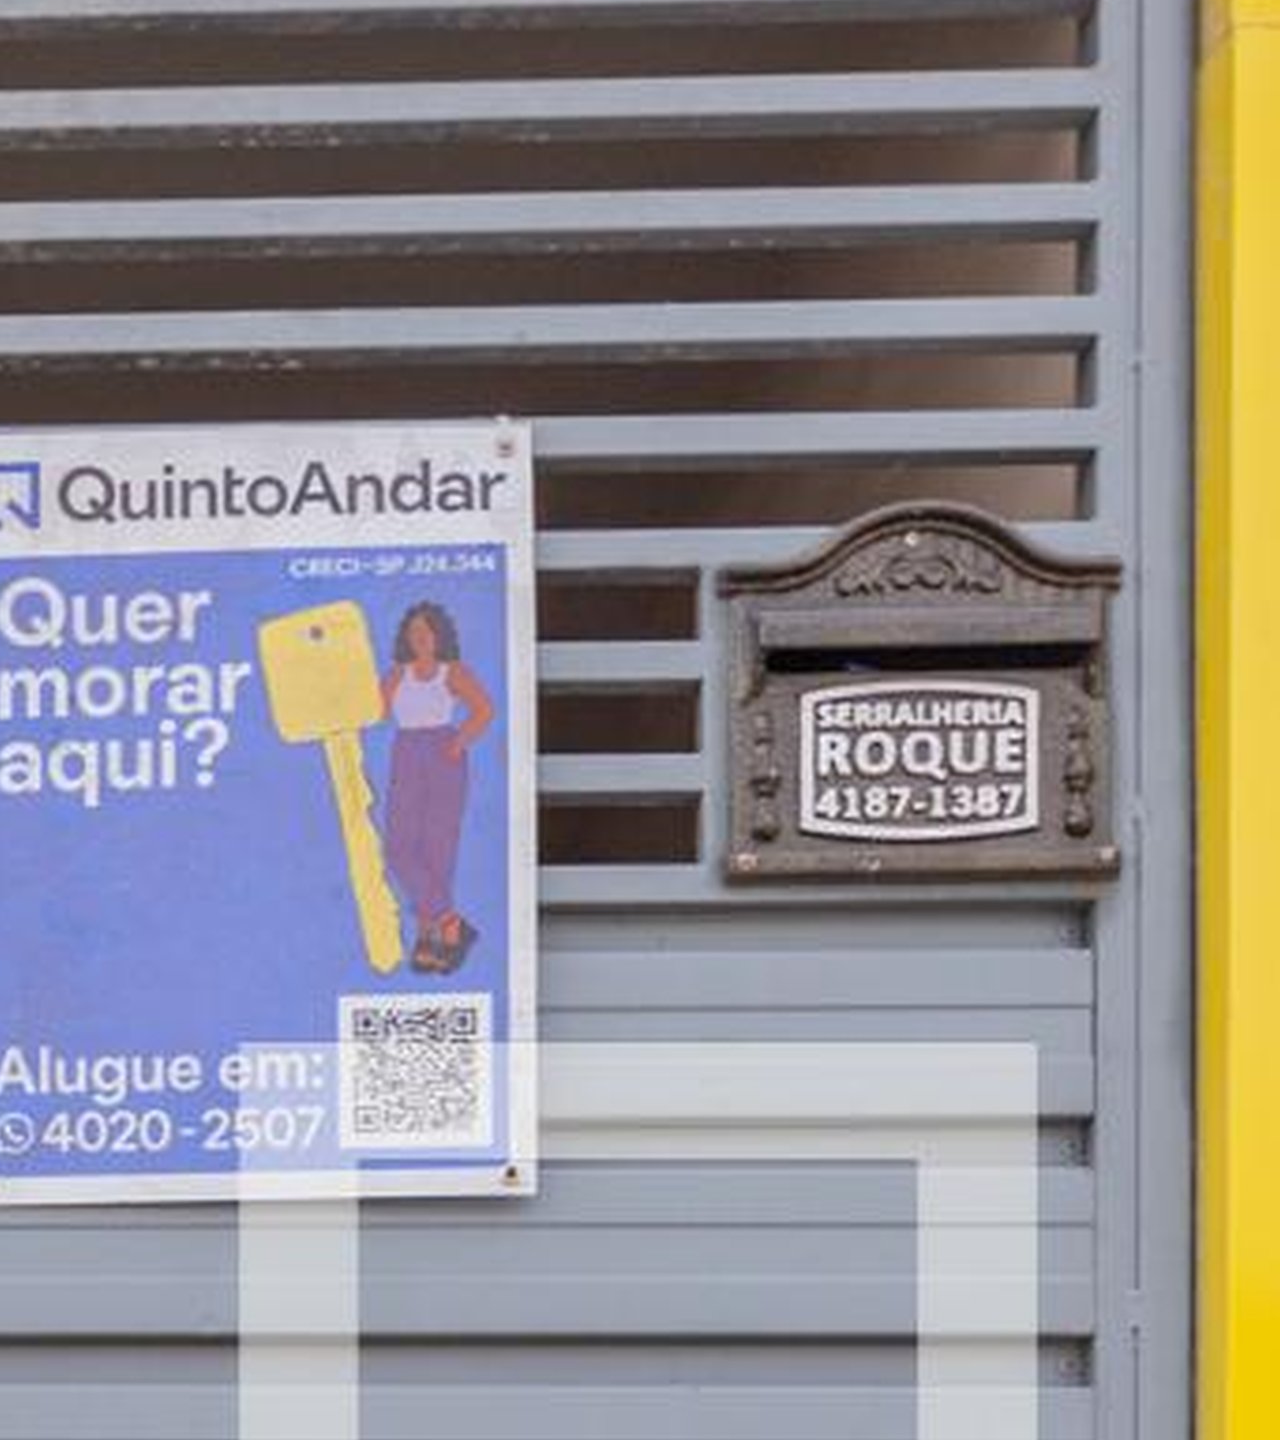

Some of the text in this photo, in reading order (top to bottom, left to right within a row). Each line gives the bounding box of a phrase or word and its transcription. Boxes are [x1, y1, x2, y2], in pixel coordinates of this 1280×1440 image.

[57, 461, 507, 523] QuintoAndar
[817, 697, 1025, 728] SERRALHERIA
[818, 729, 1025, 780] ROQUE
[816, 783, 1024, 819] 4187-1387
[218, 1051, 323, 1091] em:
[40, 1107, 325, 1154] 4020-2507
